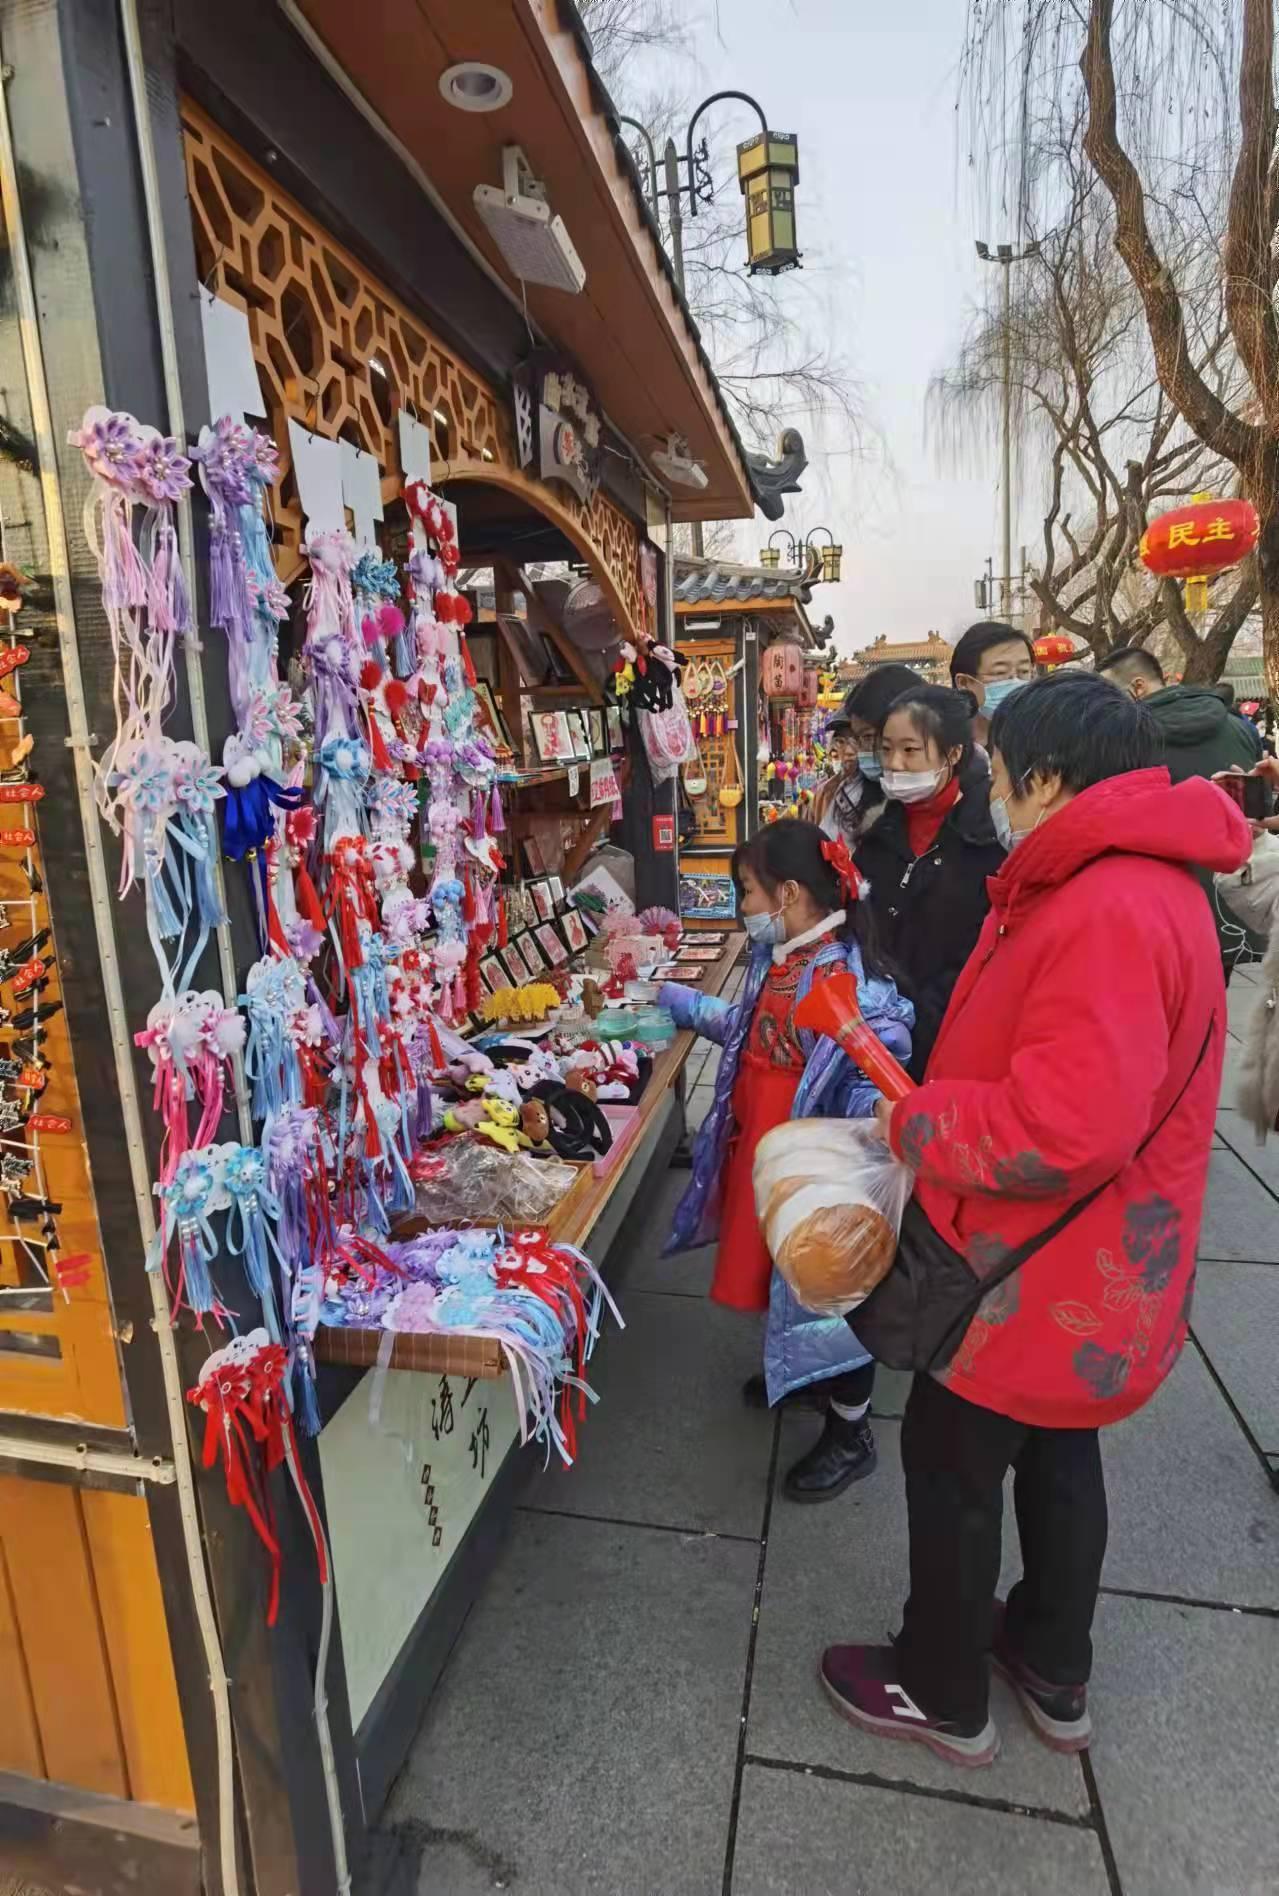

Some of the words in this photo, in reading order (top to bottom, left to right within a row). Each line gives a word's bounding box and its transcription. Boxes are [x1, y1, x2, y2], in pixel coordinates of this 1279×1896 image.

[1168, 518, 1235, 549] 民主
[5, 786, 43, 798] 社会人
[3, 831, 33, 842] 社会人
